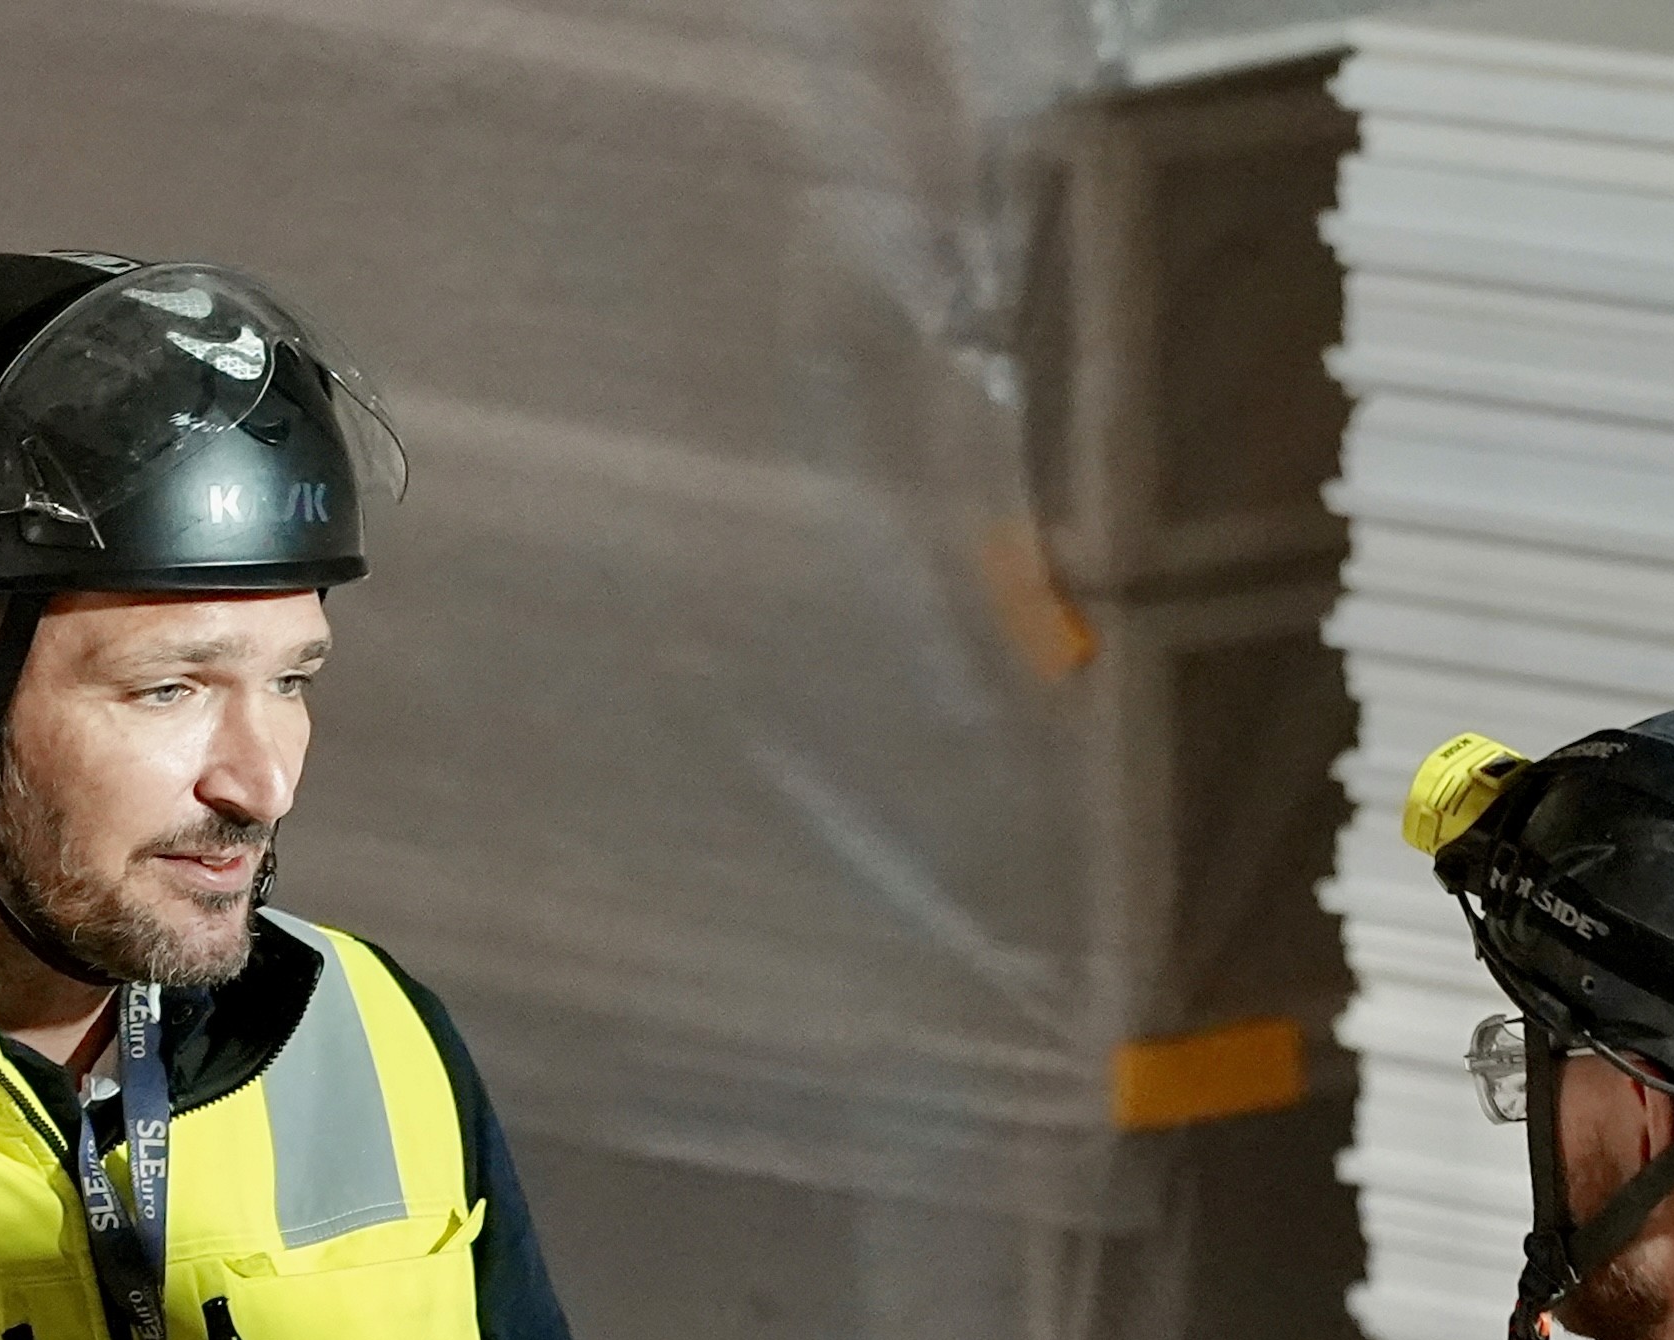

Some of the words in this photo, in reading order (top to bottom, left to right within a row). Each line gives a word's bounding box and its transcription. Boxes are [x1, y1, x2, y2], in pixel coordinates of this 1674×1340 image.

[209, 483, 329, 523] KK
[1489, 867, 1595, 941] NSIDE
[136, 1119, 166, 1220] SLEuro
